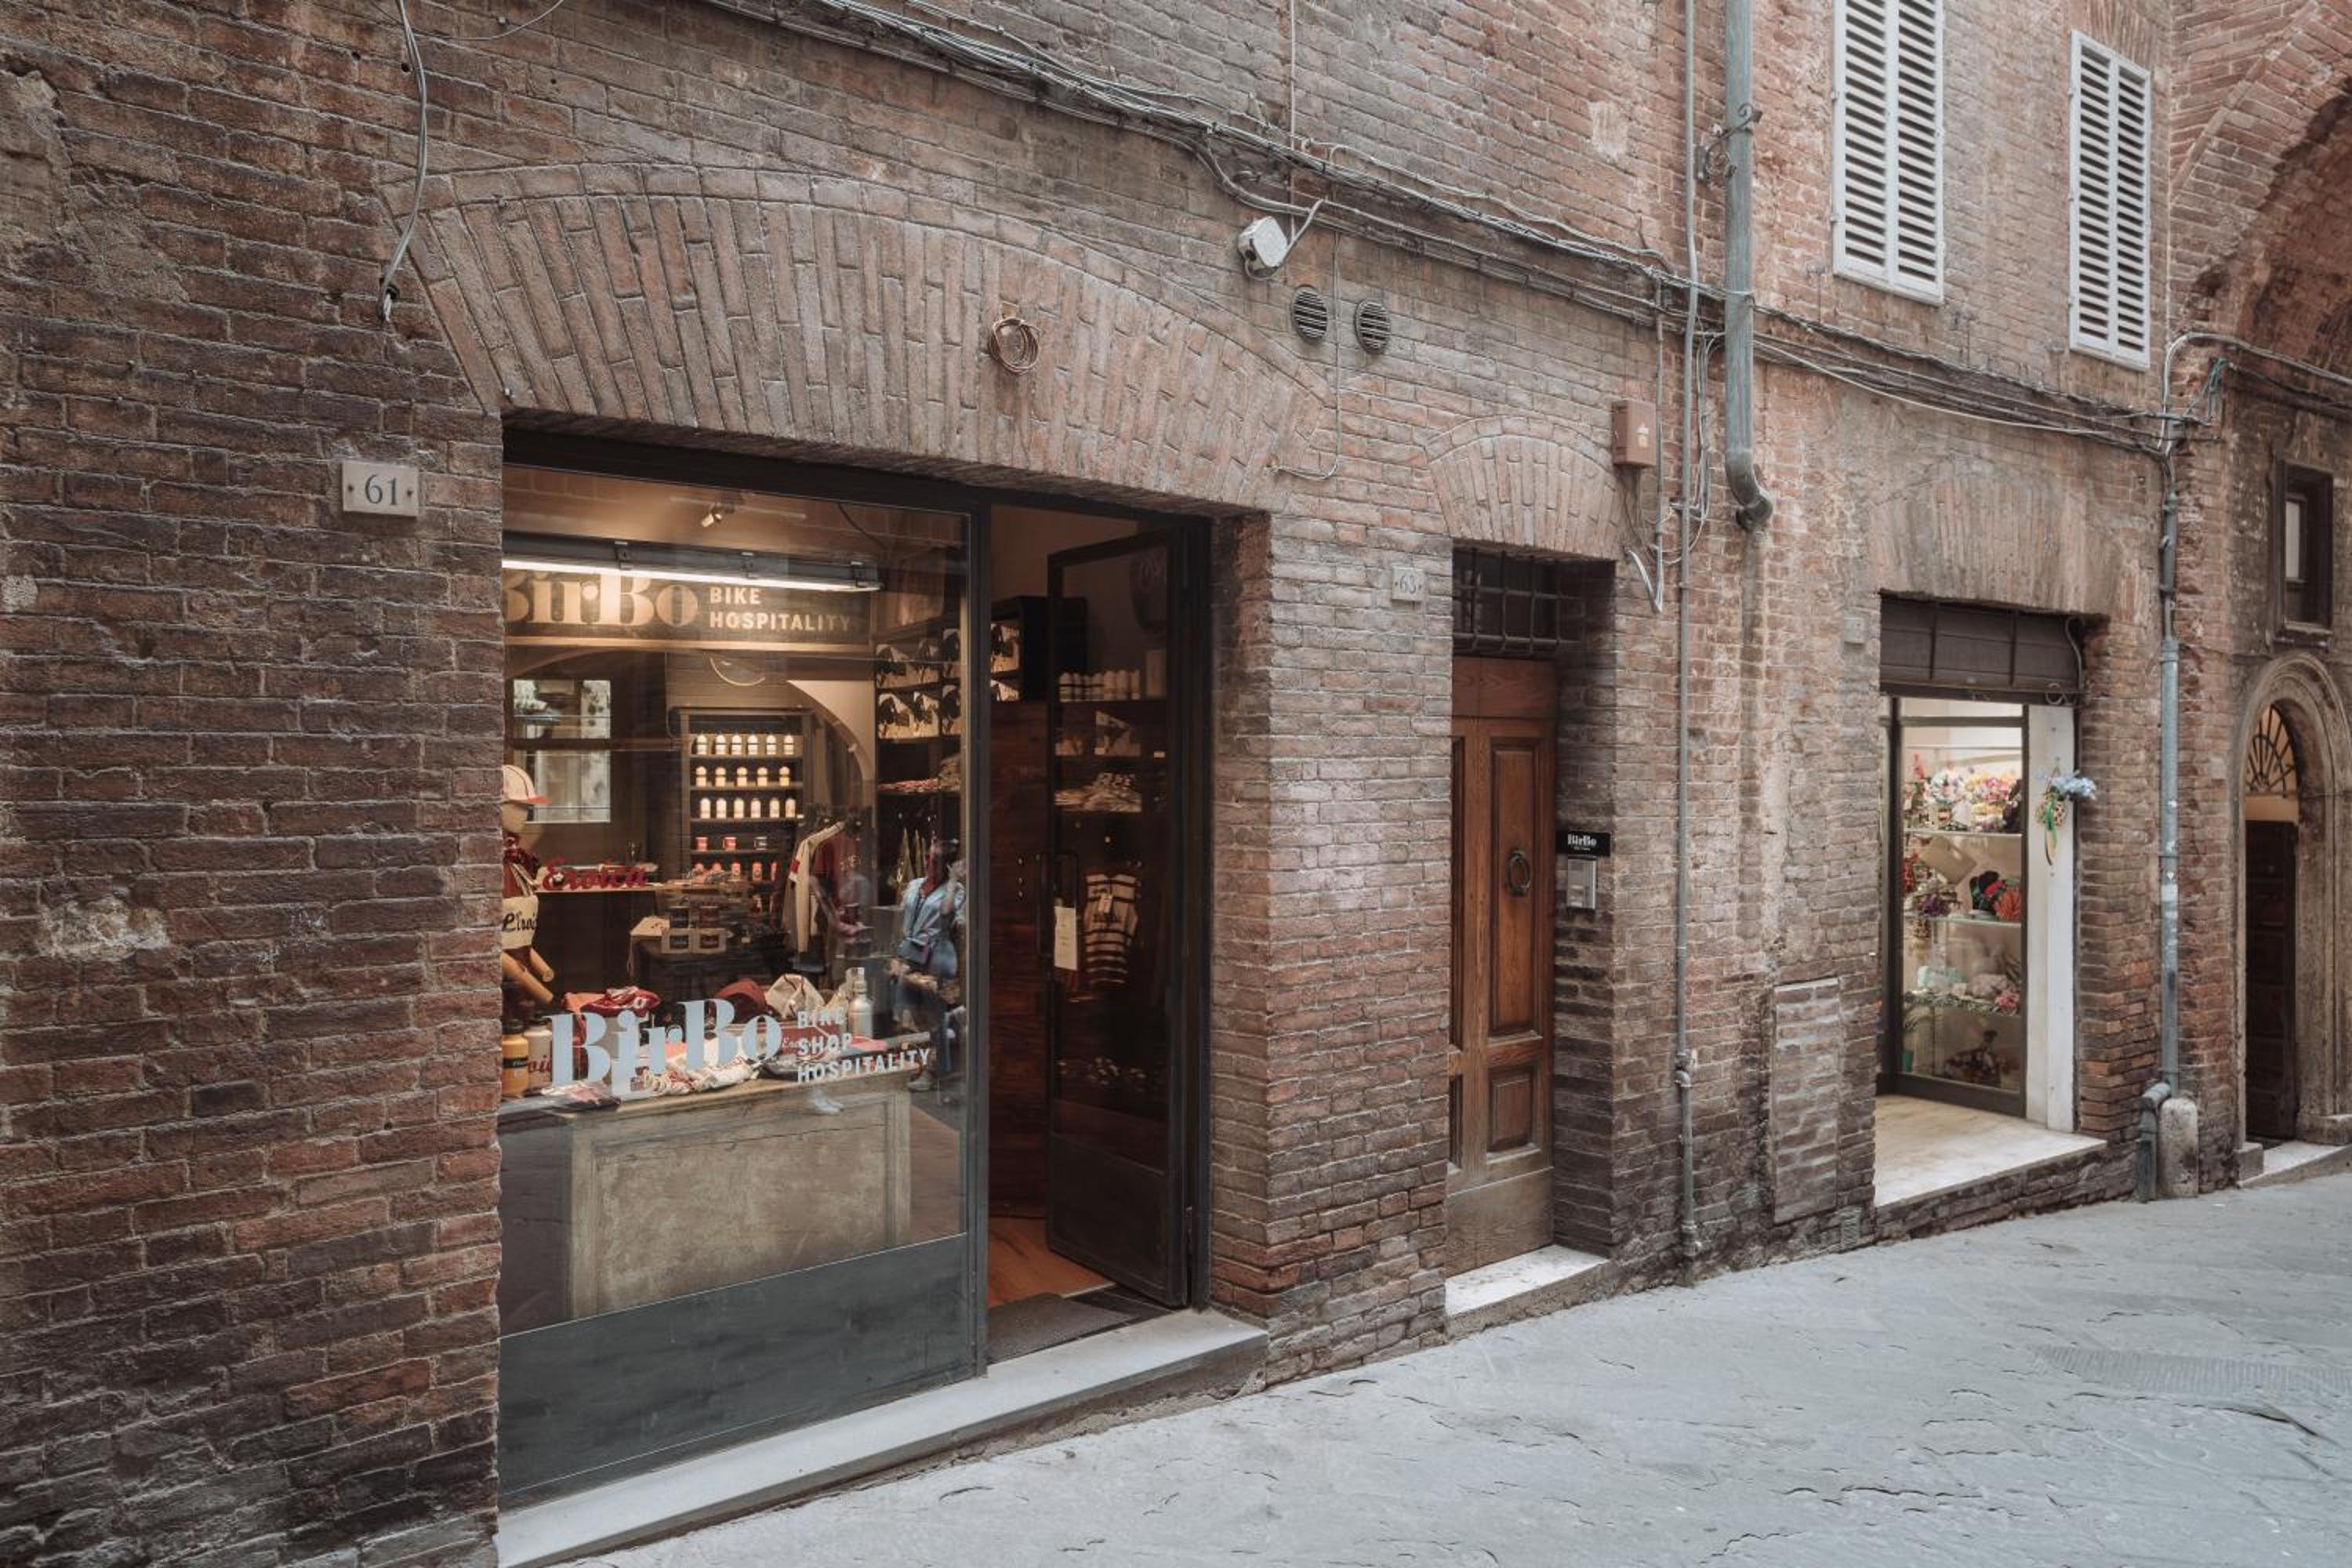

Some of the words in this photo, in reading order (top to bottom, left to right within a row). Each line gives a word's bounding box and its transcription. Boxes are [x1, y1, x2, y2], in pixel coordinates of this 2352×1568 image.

[365, 474, 399, 506] 61
[709, 586, 762, 604] BIKE
[1399, 574, 1417, 594] 63
[709, 612, 851, 632] HOSPITALITY
[797, 1007, 846, 1029] BIKE
[541, 998, 782, 1087] BirBo
[797, 1033, 854, 1056] SHOP
[797, 1048, 930, 1084] HOSPITALITY
